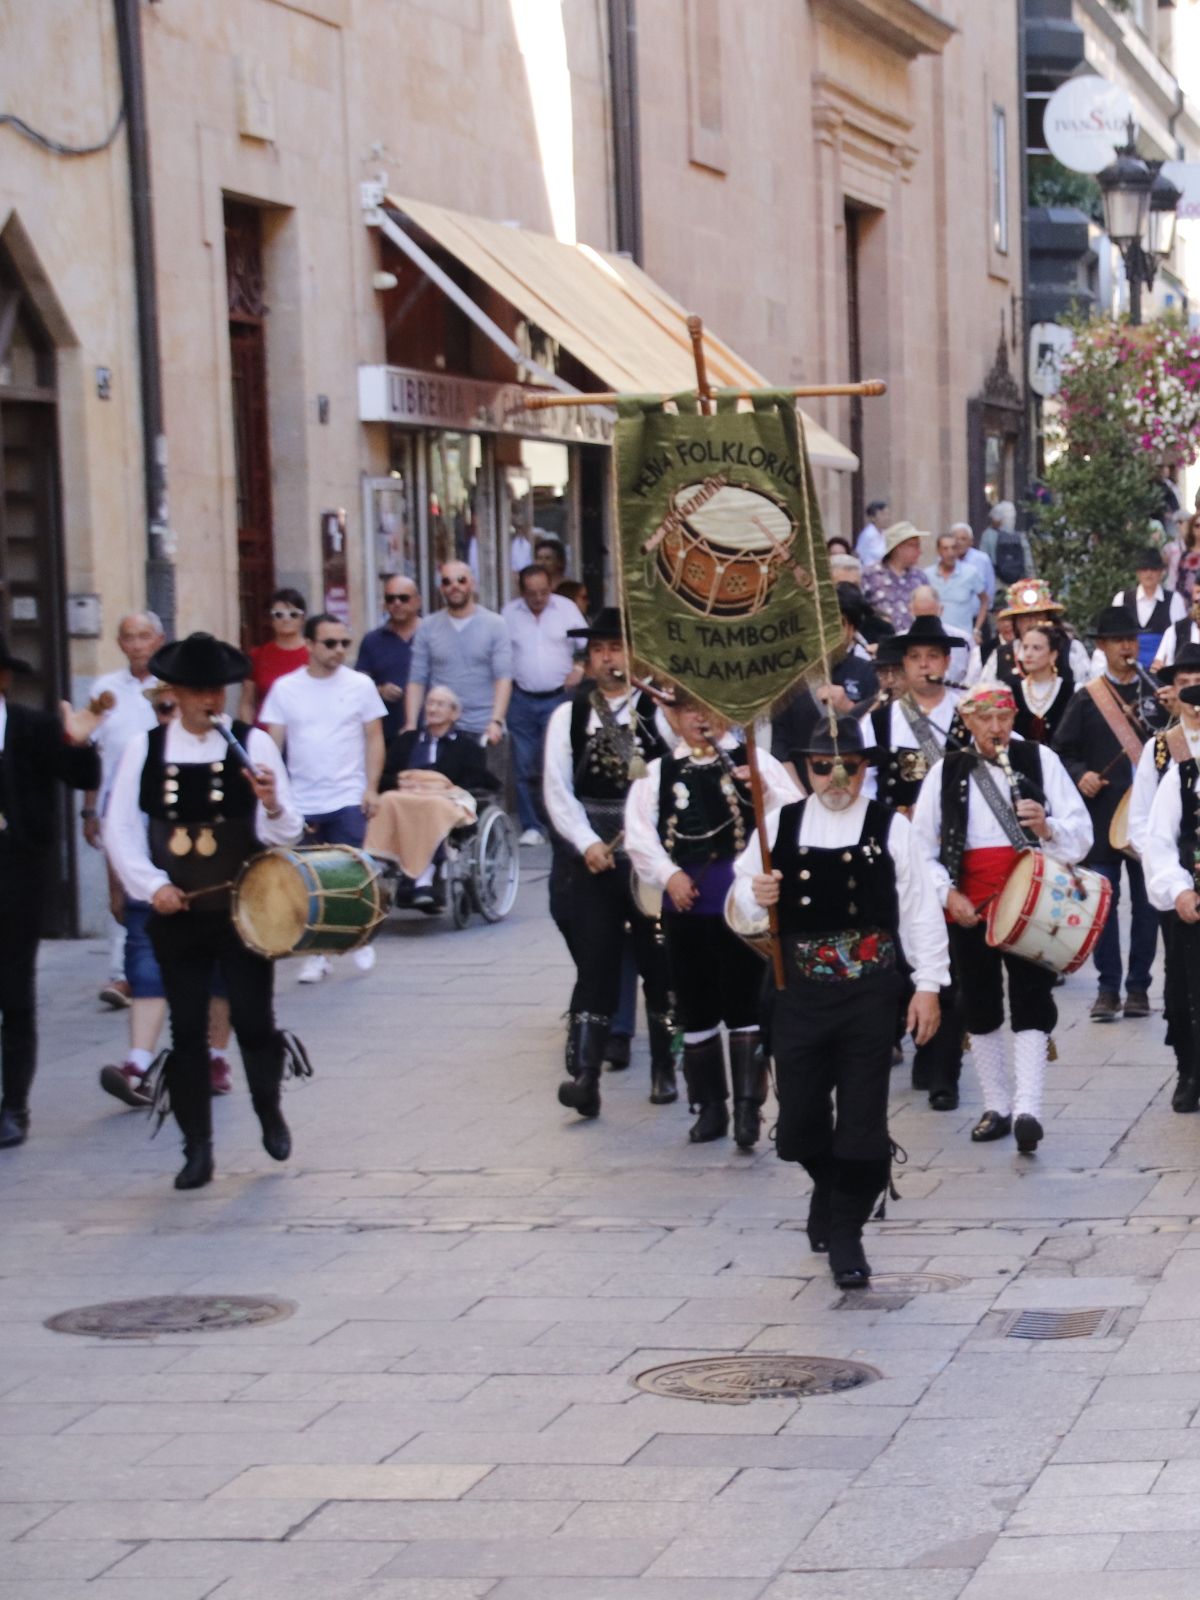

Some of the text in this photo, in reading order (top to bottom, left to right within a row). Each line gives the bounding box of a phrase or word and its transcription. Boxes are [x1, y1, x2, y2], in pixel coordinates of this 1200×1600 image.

[667, 611, 806, 649] EL TAMBORIL
[669, 644, 808, 681] SALAMANCA
